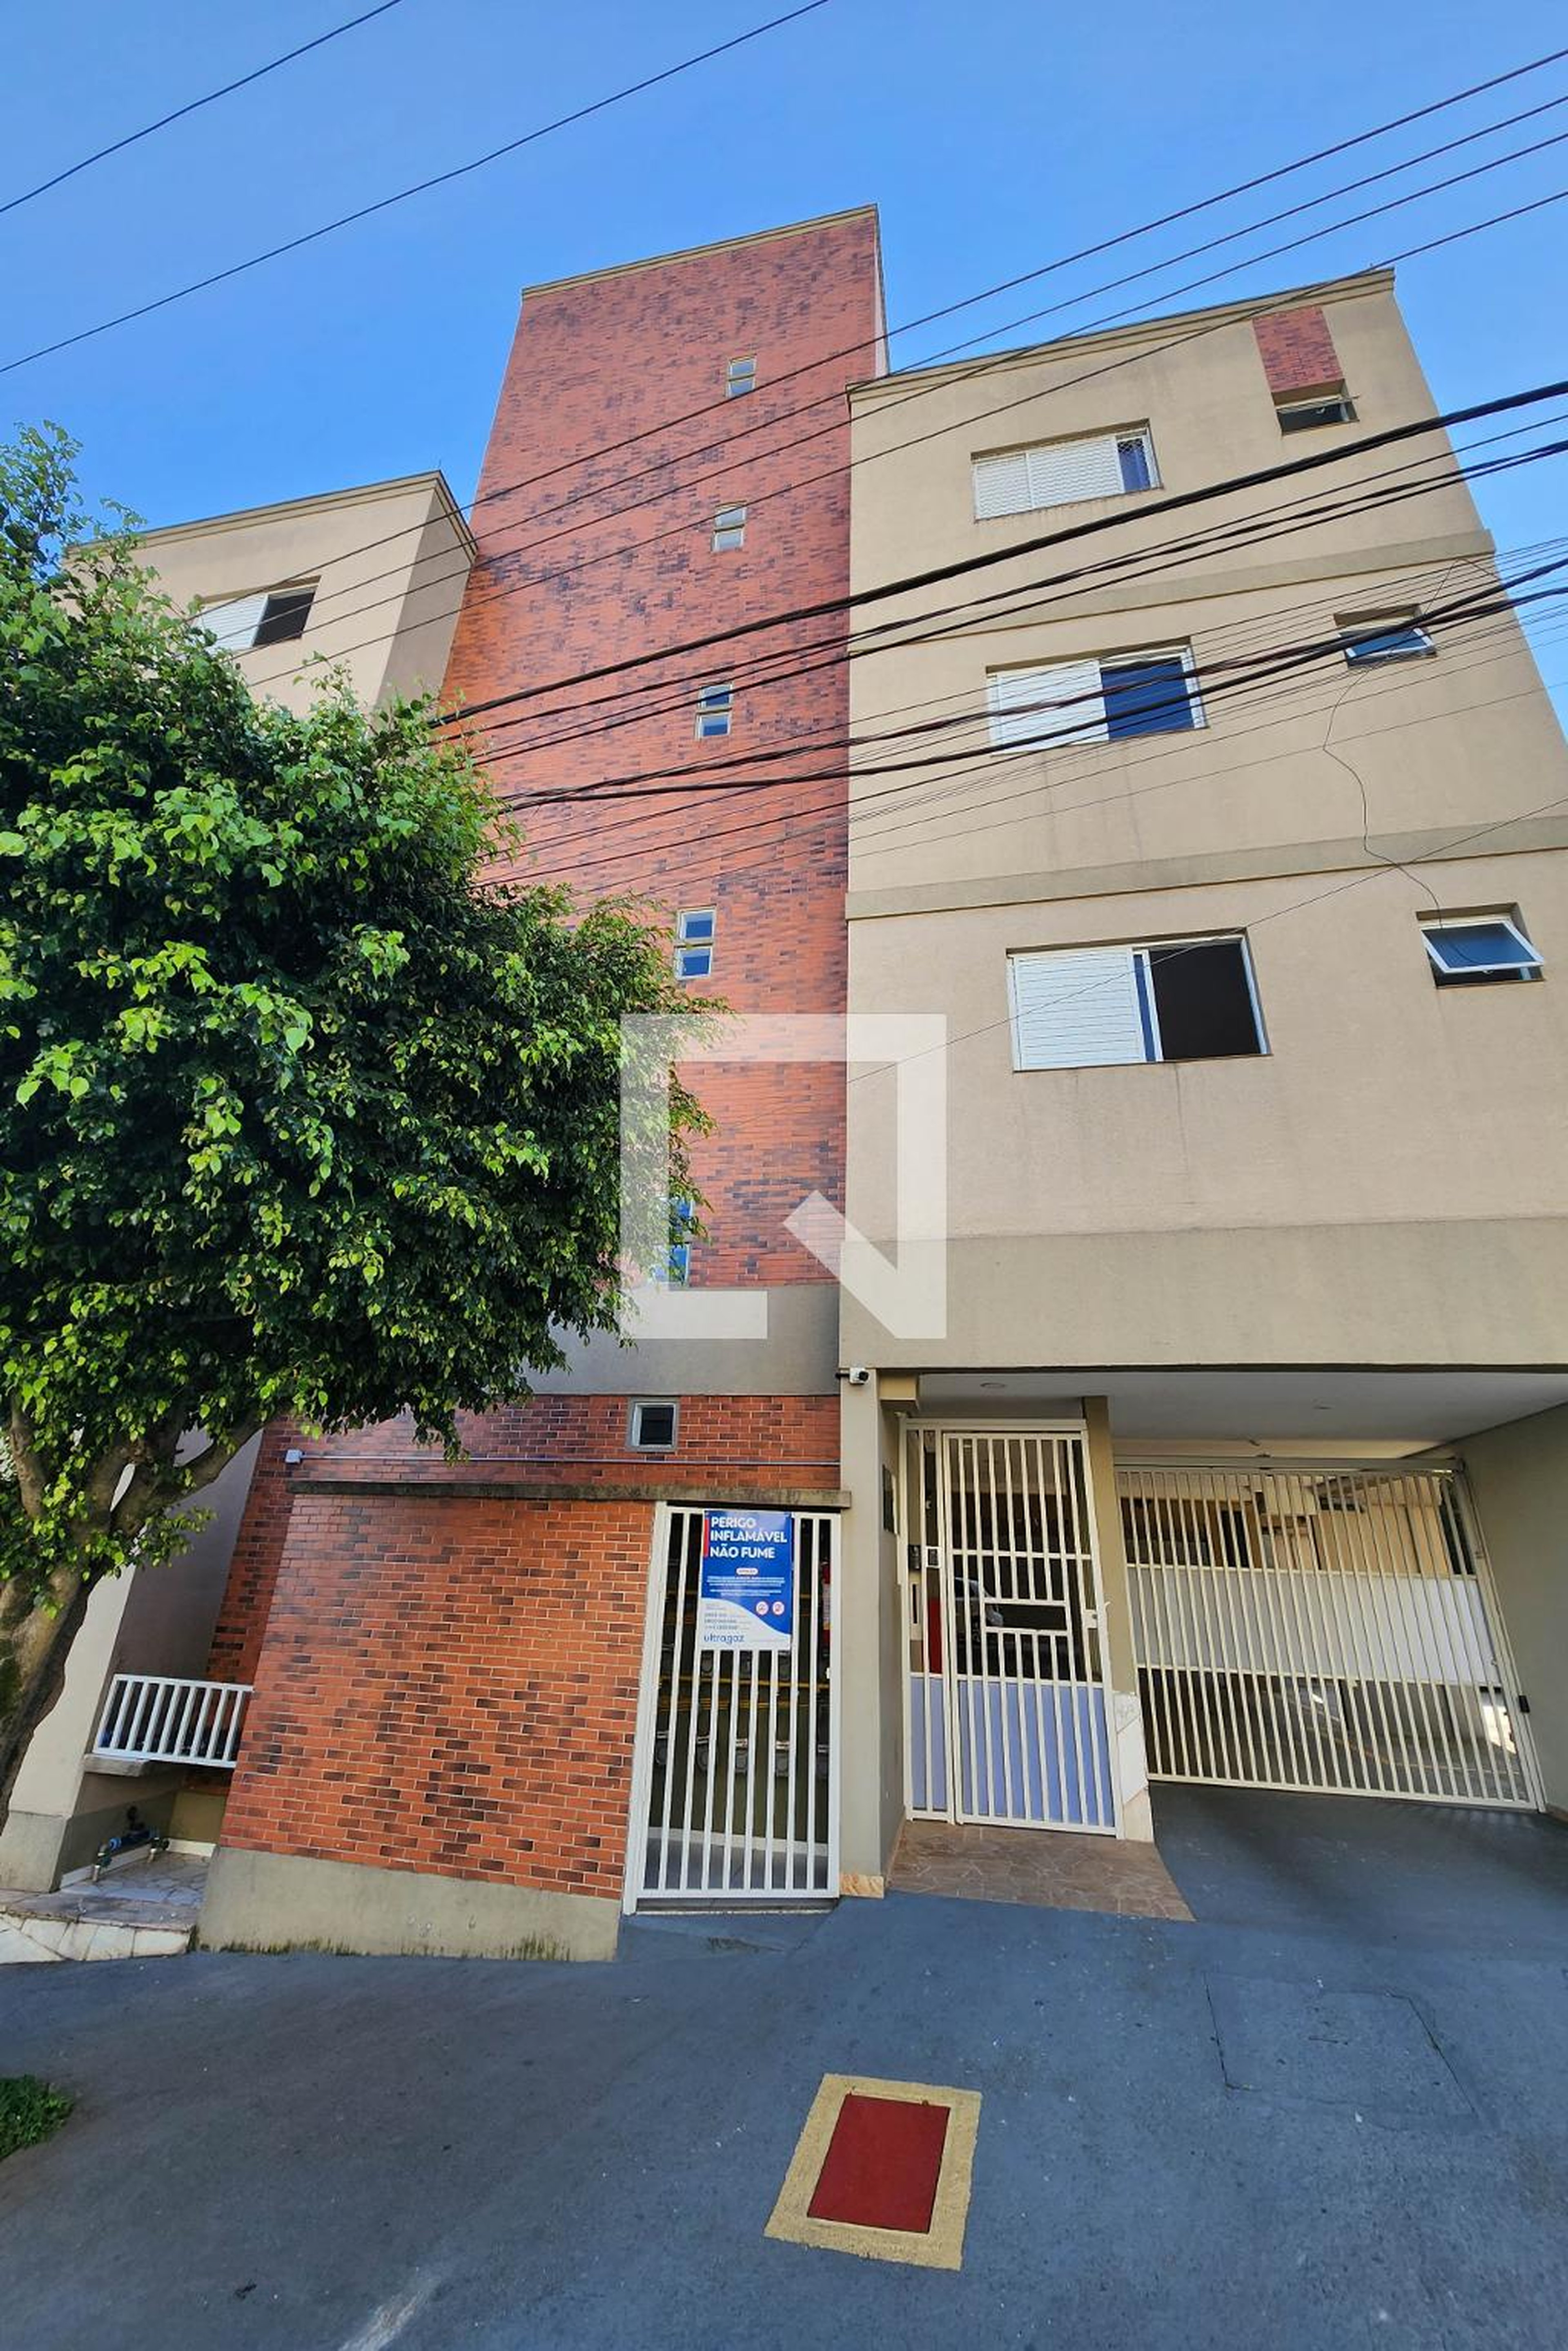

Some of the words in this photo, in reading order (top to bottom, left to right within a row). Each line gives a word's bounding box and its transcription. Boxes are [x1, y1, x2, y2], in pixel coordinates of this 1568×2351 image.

[711, 1517, 756, 1528] PERIGO
[710, 1528, 787, 1543] INFLAMÁVEL
[710, 1543, 739, 1558] NÃO
[741, 1547, 775, 1558] FUME
[704, 1633, 744, 1644] ultragaz
